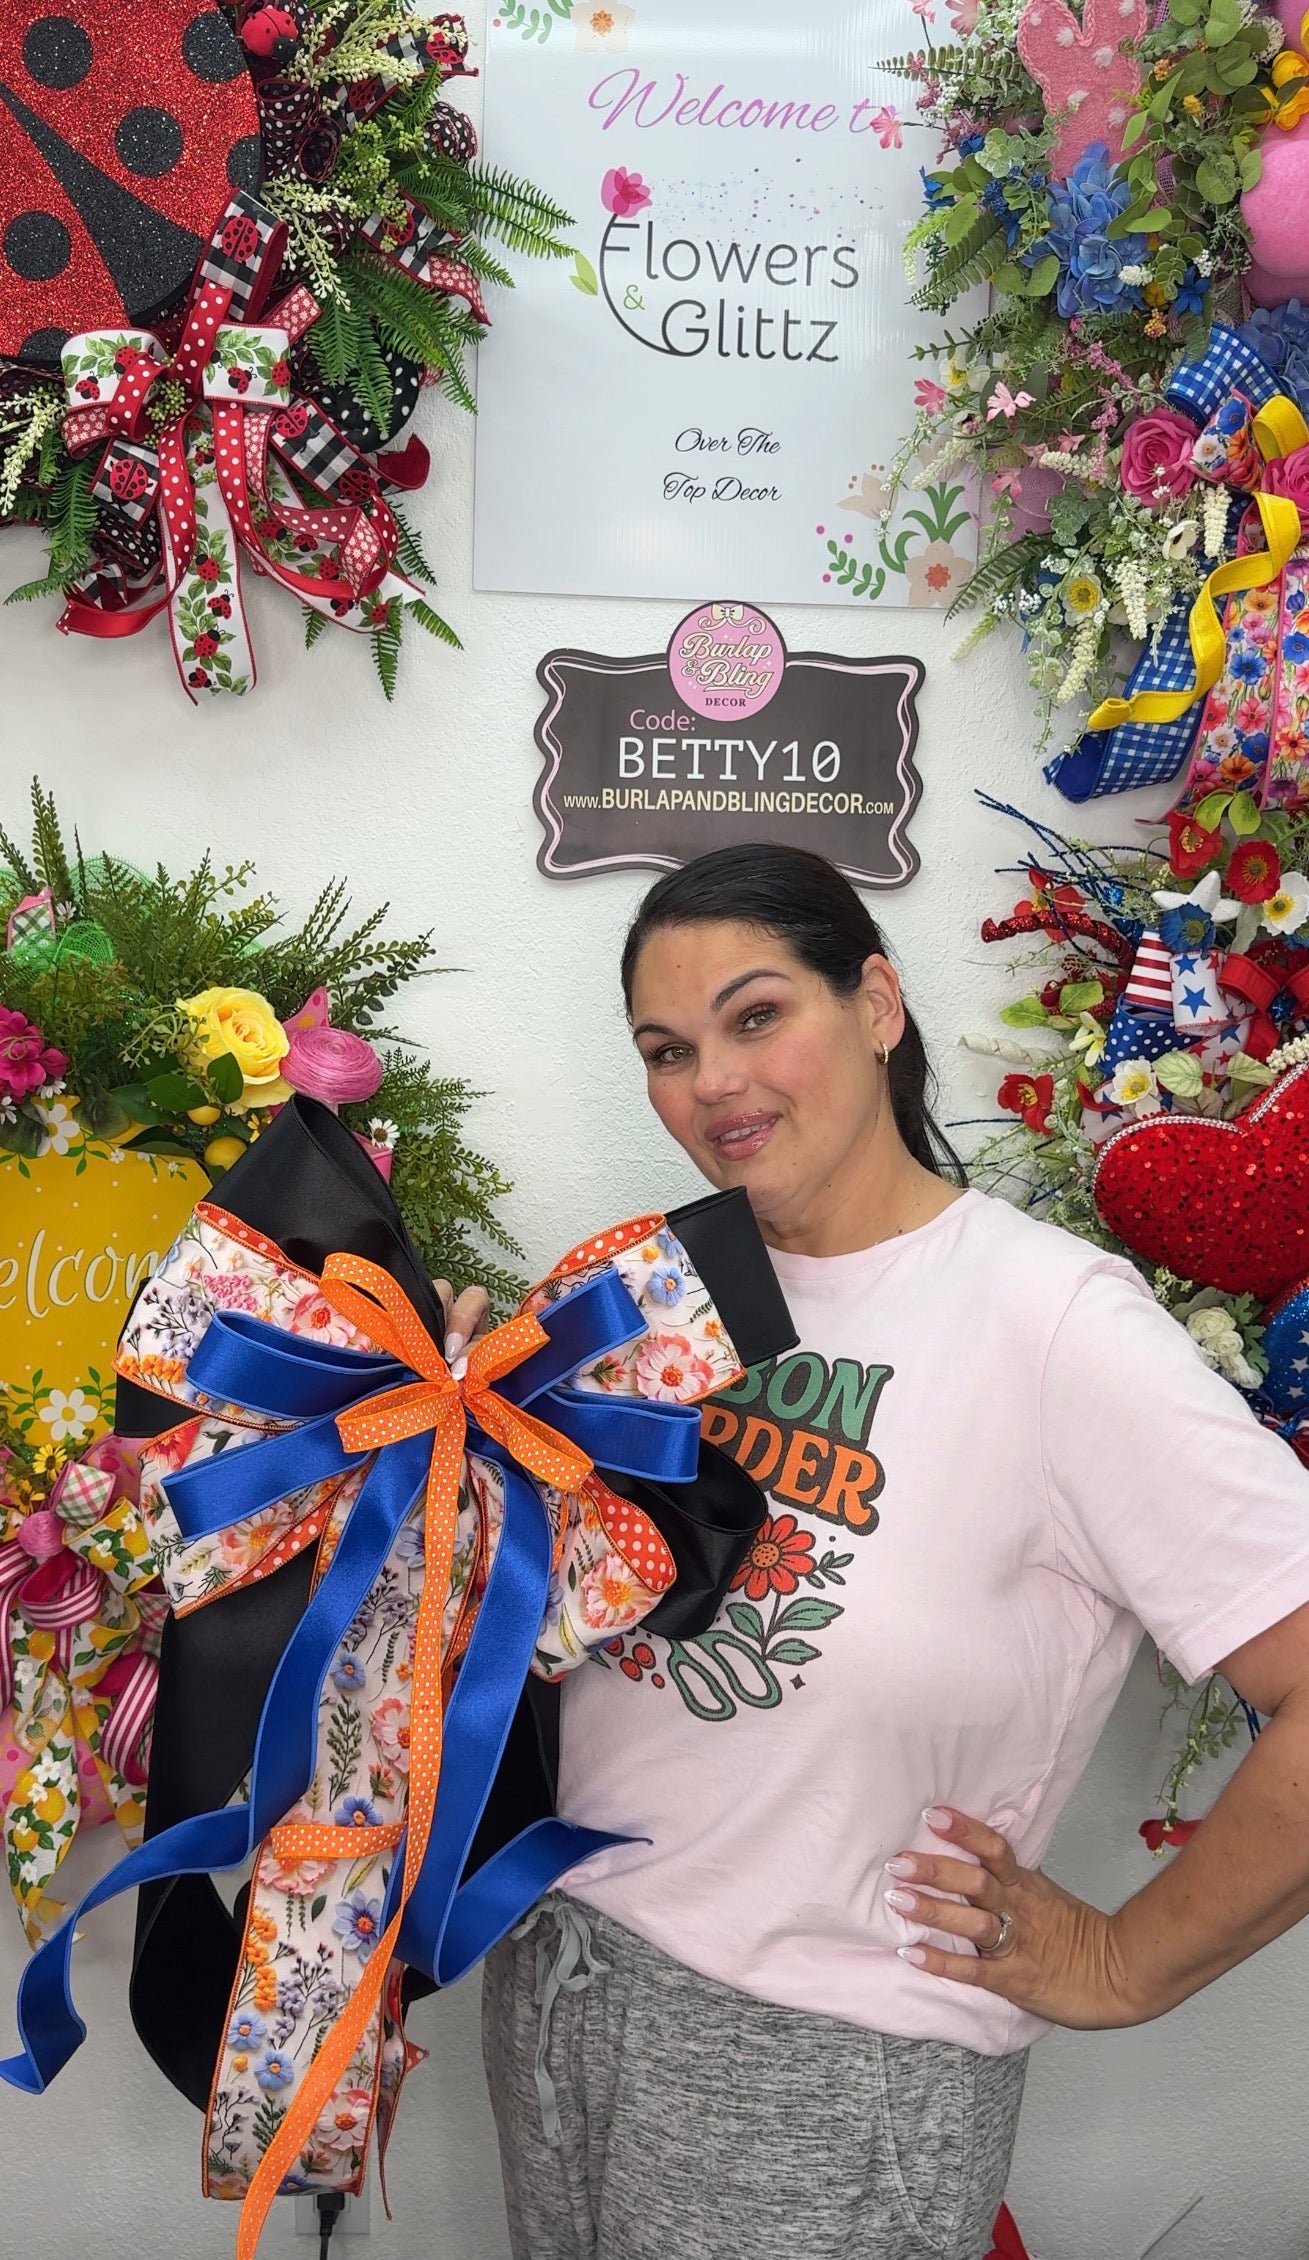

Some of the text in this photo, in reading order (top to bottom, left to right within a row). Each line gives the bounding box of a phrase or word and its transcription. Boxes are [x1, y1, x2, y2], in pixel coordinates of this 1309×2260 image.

[587, 68, 839, 132] Welcome
[599, 213, 859, 289] Flowers
[623, 284, 645, 310] &
[661, 298, 839, 362] Glittz
[675, 427, 781, 456] Over The
[663, 471, 782, 504] Top Decor
[679, 631, 773, 666] Burlap
[681, 659, 774, 699] & Bling
[705, 697, 746, 707] DECOR
[629, 708, 697, 732] Code:
[618, 736, 841, 783] BETTY10
